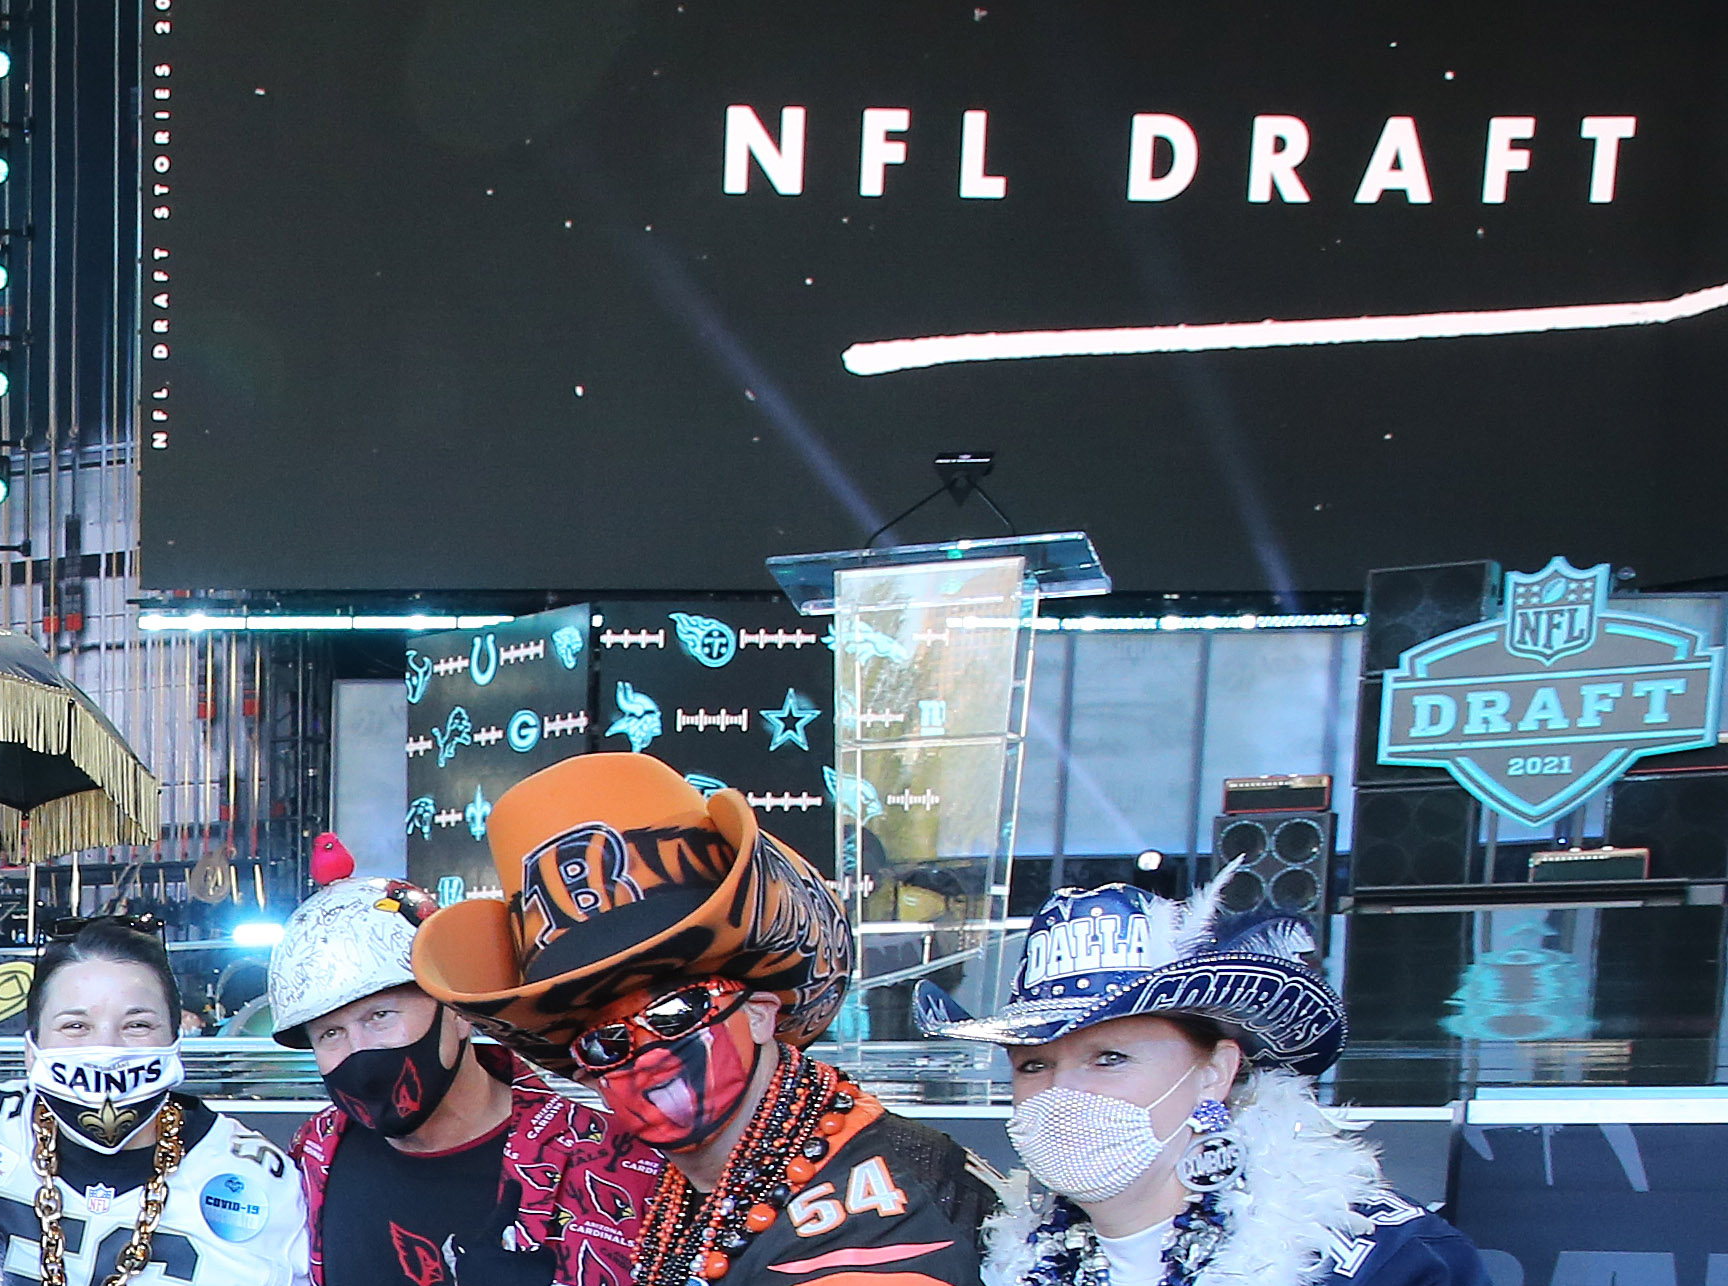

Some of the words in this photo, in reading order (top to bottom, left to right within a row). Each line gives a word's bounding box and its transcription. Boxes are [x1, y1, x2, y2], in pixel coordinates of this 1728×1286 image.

[153, 63, 171, 220] STORIES
[723, 104, 1007, 200] NFL
[1127, 112, 1637, 205] DRAFT
[152, 246, 170, 360] DRAFT
[152, 386, 169, 450] NFL
[1514, 607, 1586, 650] NFL
[1408, 677, 1688, 738] DRAFT
[1506, 756, 1574, 776] 2021
[1024, 914, 1152, 989] DALLA
[1144, 966, 1339, 1052] COWBOYS
[51, 1059, 163, 1094] SAINTS
[204, 1195, 262, 1216] COVID-19
[787, 1155, 909, 1238] 54
[568, 1223, 637, 1248] CARDINALS
